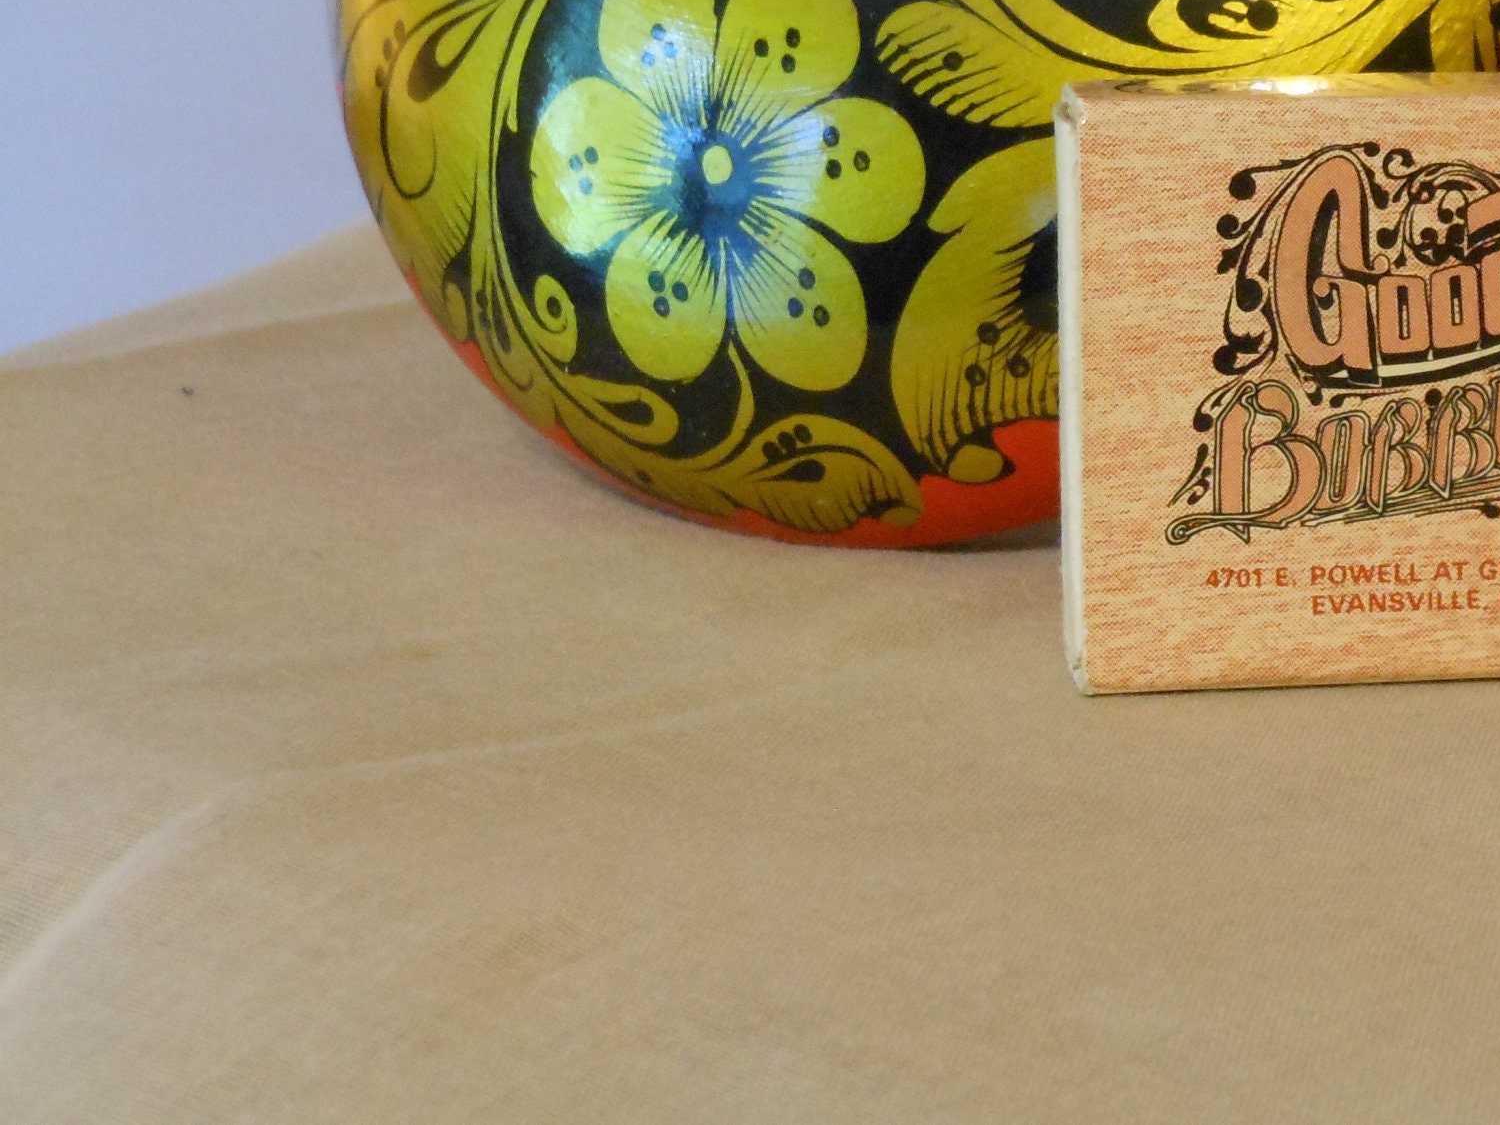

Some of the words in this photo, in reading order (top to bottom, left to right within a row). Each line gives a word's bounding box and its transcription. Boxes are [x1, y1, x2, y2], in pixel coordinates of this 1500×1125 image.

[1205, 567, 1264, 589] 4701
[1276, 566, 1297, 588] E.
[1309, 562, 1423, 586] POWELL
[1432, 560, 1470, 582] AT
